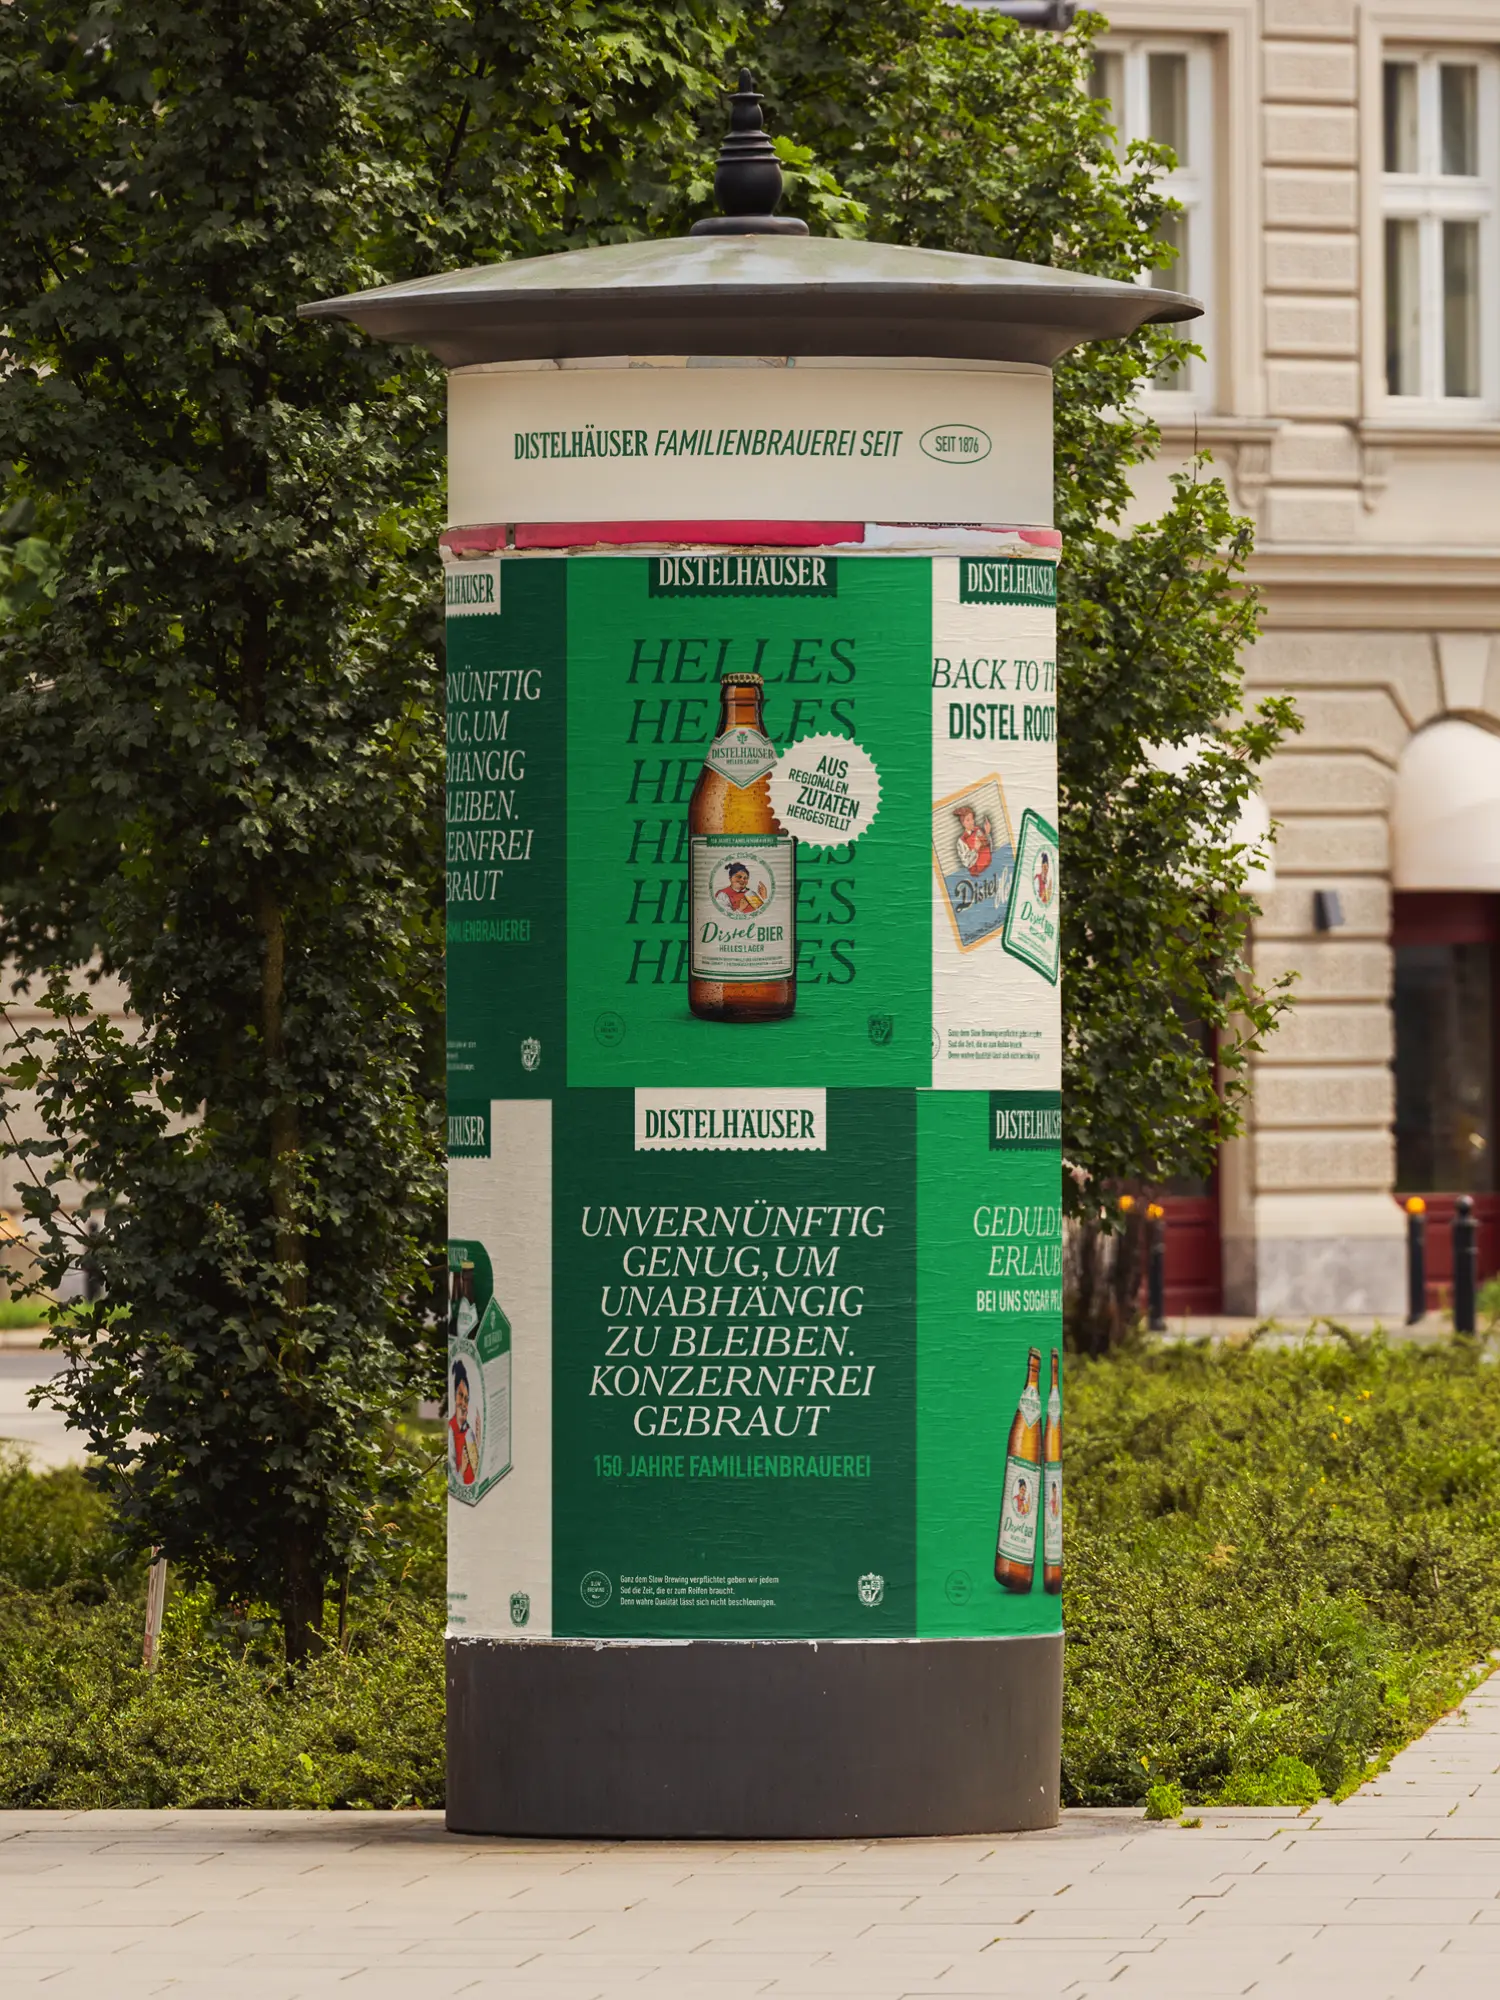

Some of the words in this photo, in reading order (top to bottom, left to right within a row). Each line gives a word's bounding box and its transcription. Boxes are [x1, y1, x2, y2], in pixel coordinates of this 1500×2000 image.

[514, 424, 648, 459] DISTELHÄUSER
[654, 429, 856, 456] FAMILIENBRAUEREI
[860, 431, 903, 456] SEIT
[935, 436, 956, 452] SEIT
[959, 437, 979, 453] 1876
[658, 557, 827, 586] DISTELHÄUSER
[625, 638, 856, 684] HELLES
[932, 657, 1006, 690] BACK
[1013, 660, 1038, 691] TO
[474, 710, 509, 741] UM
[949, 703, 1019, 740] DISTEL
[788, 768, 849, 795] REGIONALEN
[816, 755, 848, 779] AUS
[446, 790, 519, 822] LEIBEN.
[796, 786, 860, 819] ZUTATEN
[786, 804, 851, 832] HERGESTELLT
[446, 829, 534, 862] ERNFREI
[701, 921, 756, 944] Distel
[757, 926, 783, 942] BIER
[719, 944, 743, 953] HELLES
[744, 944, 764, 953] LAGER
[644, 1109, 816, 1139] DISTELHÄUSER
[581, 1199, 885, 1237] UNVERNÜNFTIG
[623, 1246, 769, 1281] GENUG,
[775, 1246, 840, 1276] UM
[601, 1285, 864, 1317] UNABHÄNGIG
[976, 1290, 996, 1312] BEI
[1000, 1290, 1021, 1312] UNS
[605, 1326, 661, 1356] ZU
[669, 1326, 854, 1356] BLEIBEN.
[589, 1366, 876, 1396] KONZERNFREI
[633, 1405, 830, 1436] GEBRAUT
[594, 1455, 622, 1477] 150
[627, 1455, 684, 1477] JAHRE
[689, 1455, 871, 1477] FAMILIENBRAUEREI
[620, 1575, 634, 1583] Ganz
[635, 1575, 648, 1583] dem
[648, 1575, 663, 1583] Slow
[664, 1576, 688, 1585] Brewing
[690, 1576, 726, 1585] verpflichtet
[727, 1577, 746, 1585] geben
[759, 1576, 779, 1585] jedem
[620, 1586, 631, 1594] Sud
[632, 1586, 641, 1594] die
[642, 1587, 655, 1595] Zeit,
[620, 1597, 635, 1605] Denn
[636, 1597, 654, 1605] wahre
[655, 1598, 678, 1606] Qualität
[680, 1598, 695, 1606] lässt
[696, 1598, 709, 1606] sich
[711, 1598, 727, 1606] nicht
[728, 1598, 776, 1607] beschleunigen.
